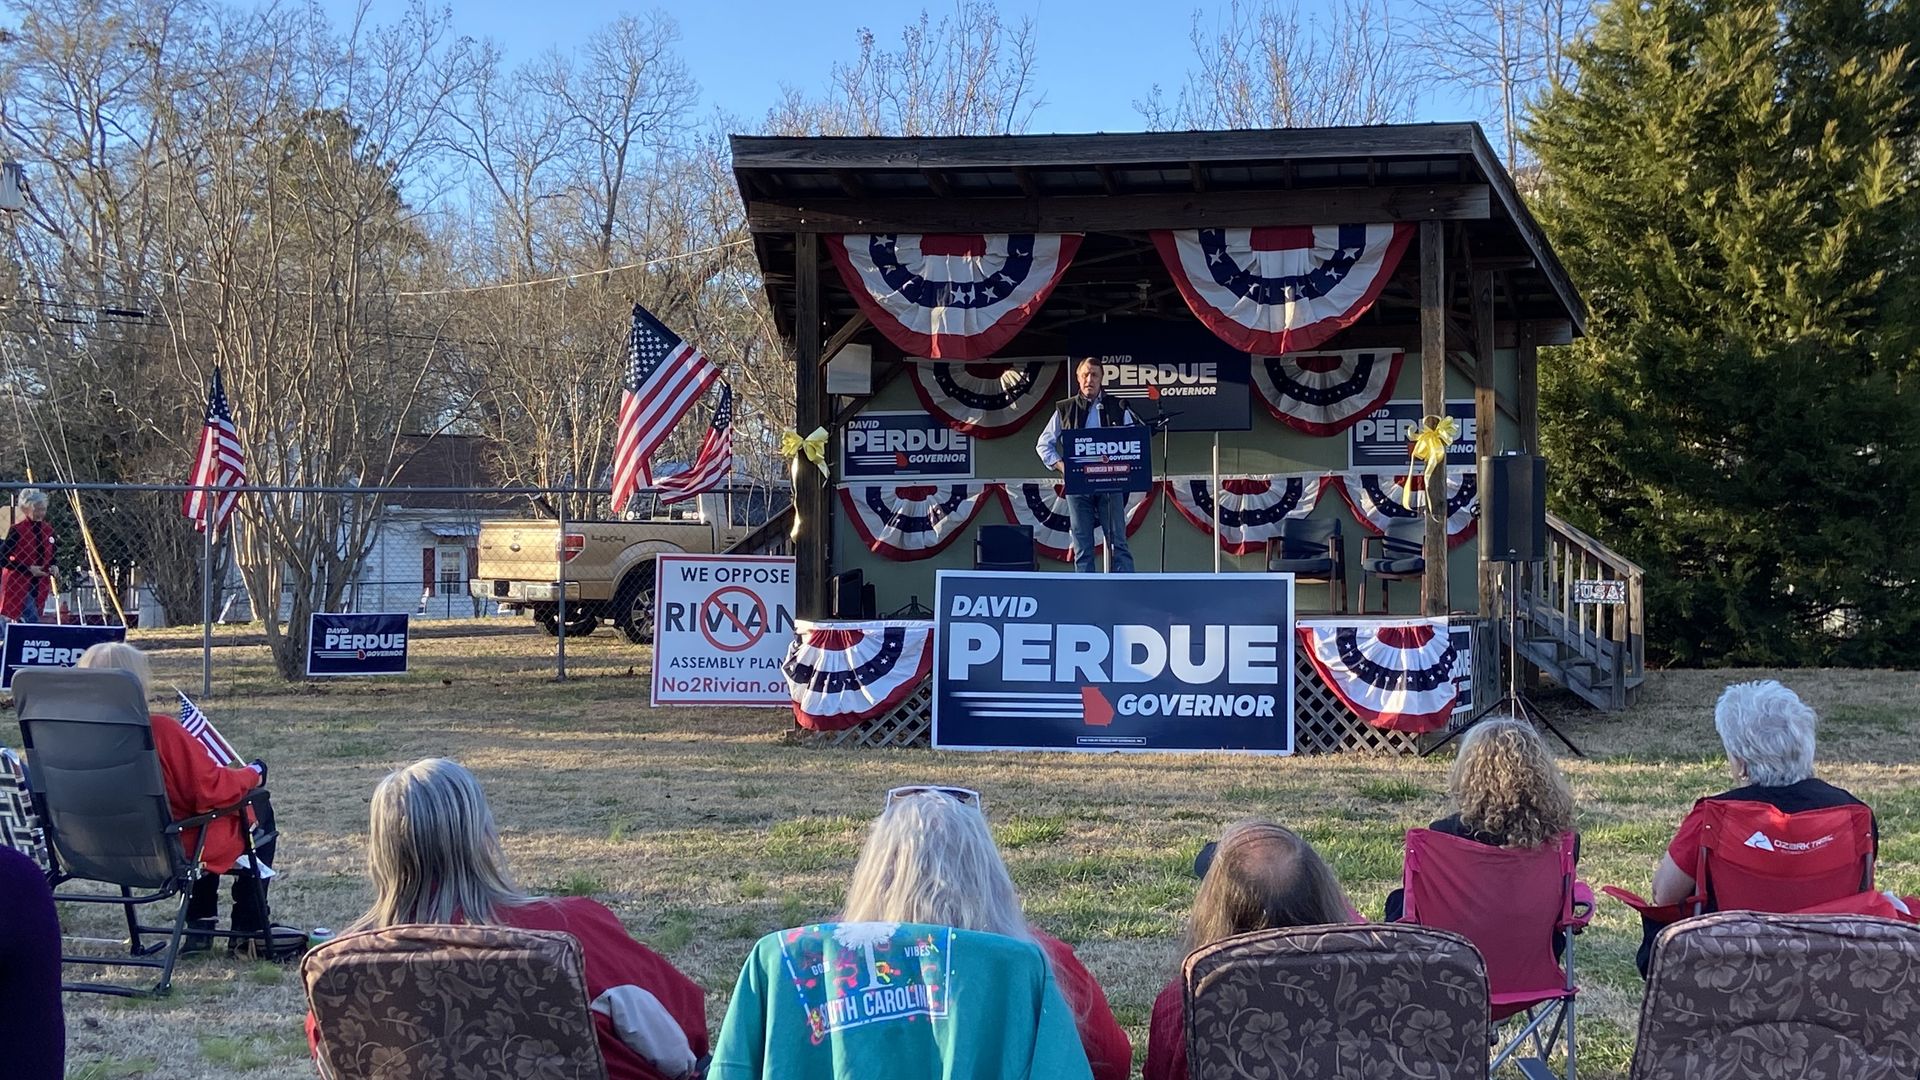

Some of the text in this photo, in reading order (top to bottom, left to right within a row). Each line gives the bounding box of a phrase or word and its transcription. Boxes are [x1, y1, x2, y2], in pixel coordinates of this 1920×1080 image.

[1101, 355, 1132, 363] DAVID
[1101, 362, 1217, 386] PERDUE
[1160, 386, 1217, 396] GOVERNOR
[1368, 409, 1390, 418] VID
[848, 420, 880, 429] DAVID
[1356, 418, 1476, 442] PERUE
[848, 429, 967, 452] PERDUE
[1074, 441, 1141, 455] PERDUE
[1446, 444, 1476, 454] ERNO
[908, 454, 966, 463] GOVERNOR
[681, 567, 790, 583] WE OPPOSE
[1580, 585, 1619, 599] USA
[951, 596, 1038, 617] DAVID
[665, 602, 796, 633] RIVIAN
[325, 634, 405, 650] PERDUE
[21, 647, 86, 664] PERD
[948, 622, 1278, 684] PERDUE
[670, 657, 784, 669] ASSEMBLY PLAN
[662, 677, 790, 695] No2Rivian.or
[1117, 693, 1275, 717] GOVERNOR
[904, 944, 931, 958] VIBES
